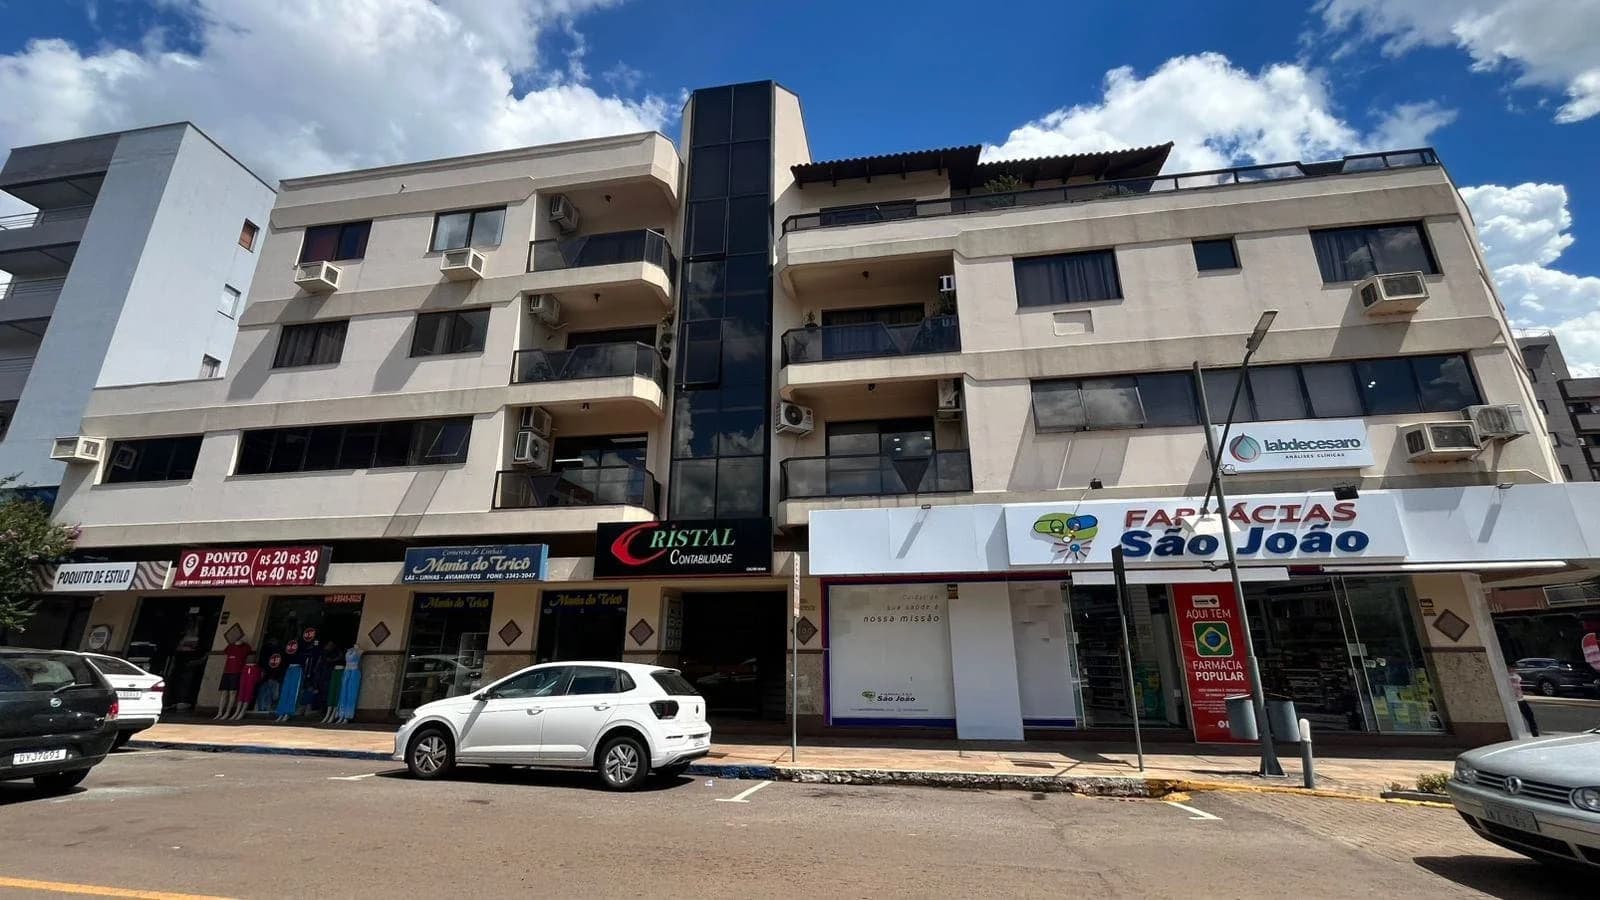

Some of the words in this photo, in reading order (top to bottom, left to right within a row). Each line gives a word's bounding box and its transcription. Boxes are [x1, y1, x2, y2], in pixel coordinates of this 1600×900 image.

[1264, 438, 1361, 451] labdecesaro
[1125, 502, 1358, 528] FARÁCIAS
[1120, 527, 1220, 558] São
[1236, 523, 1370, 555] João
[204, 551, 248, 564] PONTO
[259, 554, 271, 566] R$
[272, 551, 288, 565] 20
[289, 553, 301, 566] R$
[302, 550, 318, 564] 30
[670, 549, 733, 565] CONTABILIDADE
[199, 565, 250, 577] BARATO
[413, 557, 467, 574] Mania
[471, 556, 489, 570] do
[490, 555, 531, 570] Tricô
[57, 570, 92, 584] POQUITO
[94, 570, 105, 583] DE
[106, 569, 130, 583] ESTILO
[256, 570, 267, 581] R$
[269, 567, 285, 580] 40
[286, 569, 297, 581] R$
[299, 566, 315, 579] 50
[863, 615, 895, 623] nossa
[900, 613, 940, 622] missão
[1186, 609, 1208, 620] AQUI
[1209, 609, 1231, 619] TEM
[1192, 658, 1243, 670] FARMÁCIA
[1195, 671, 1244, 681] POPULAR
